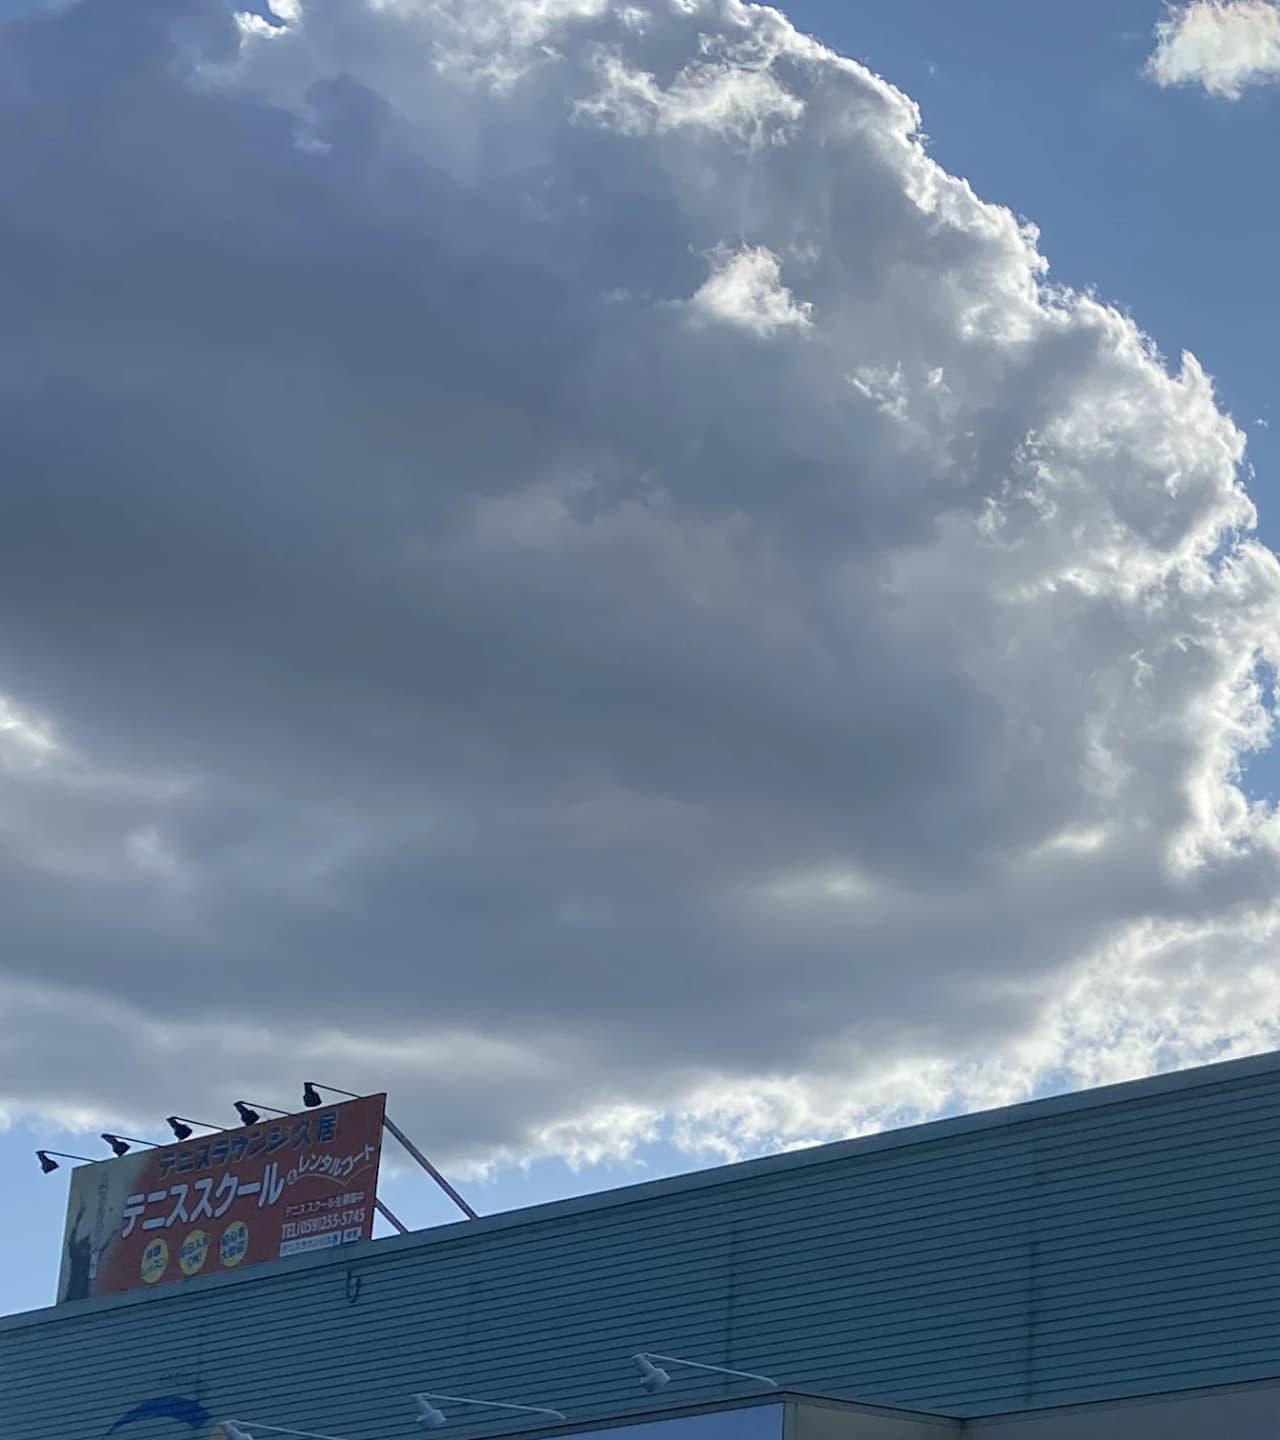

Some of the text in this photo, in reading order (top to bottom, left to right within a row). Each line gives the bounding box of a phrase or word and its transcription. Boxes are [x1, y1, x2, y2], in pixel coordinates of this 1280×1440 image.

[159, 1110, 338, 1181] テニスラウンジ久居
[297, 1143, 375, 1177] レンタルコート
[121, 1162, 287, 1240] テニススクール
